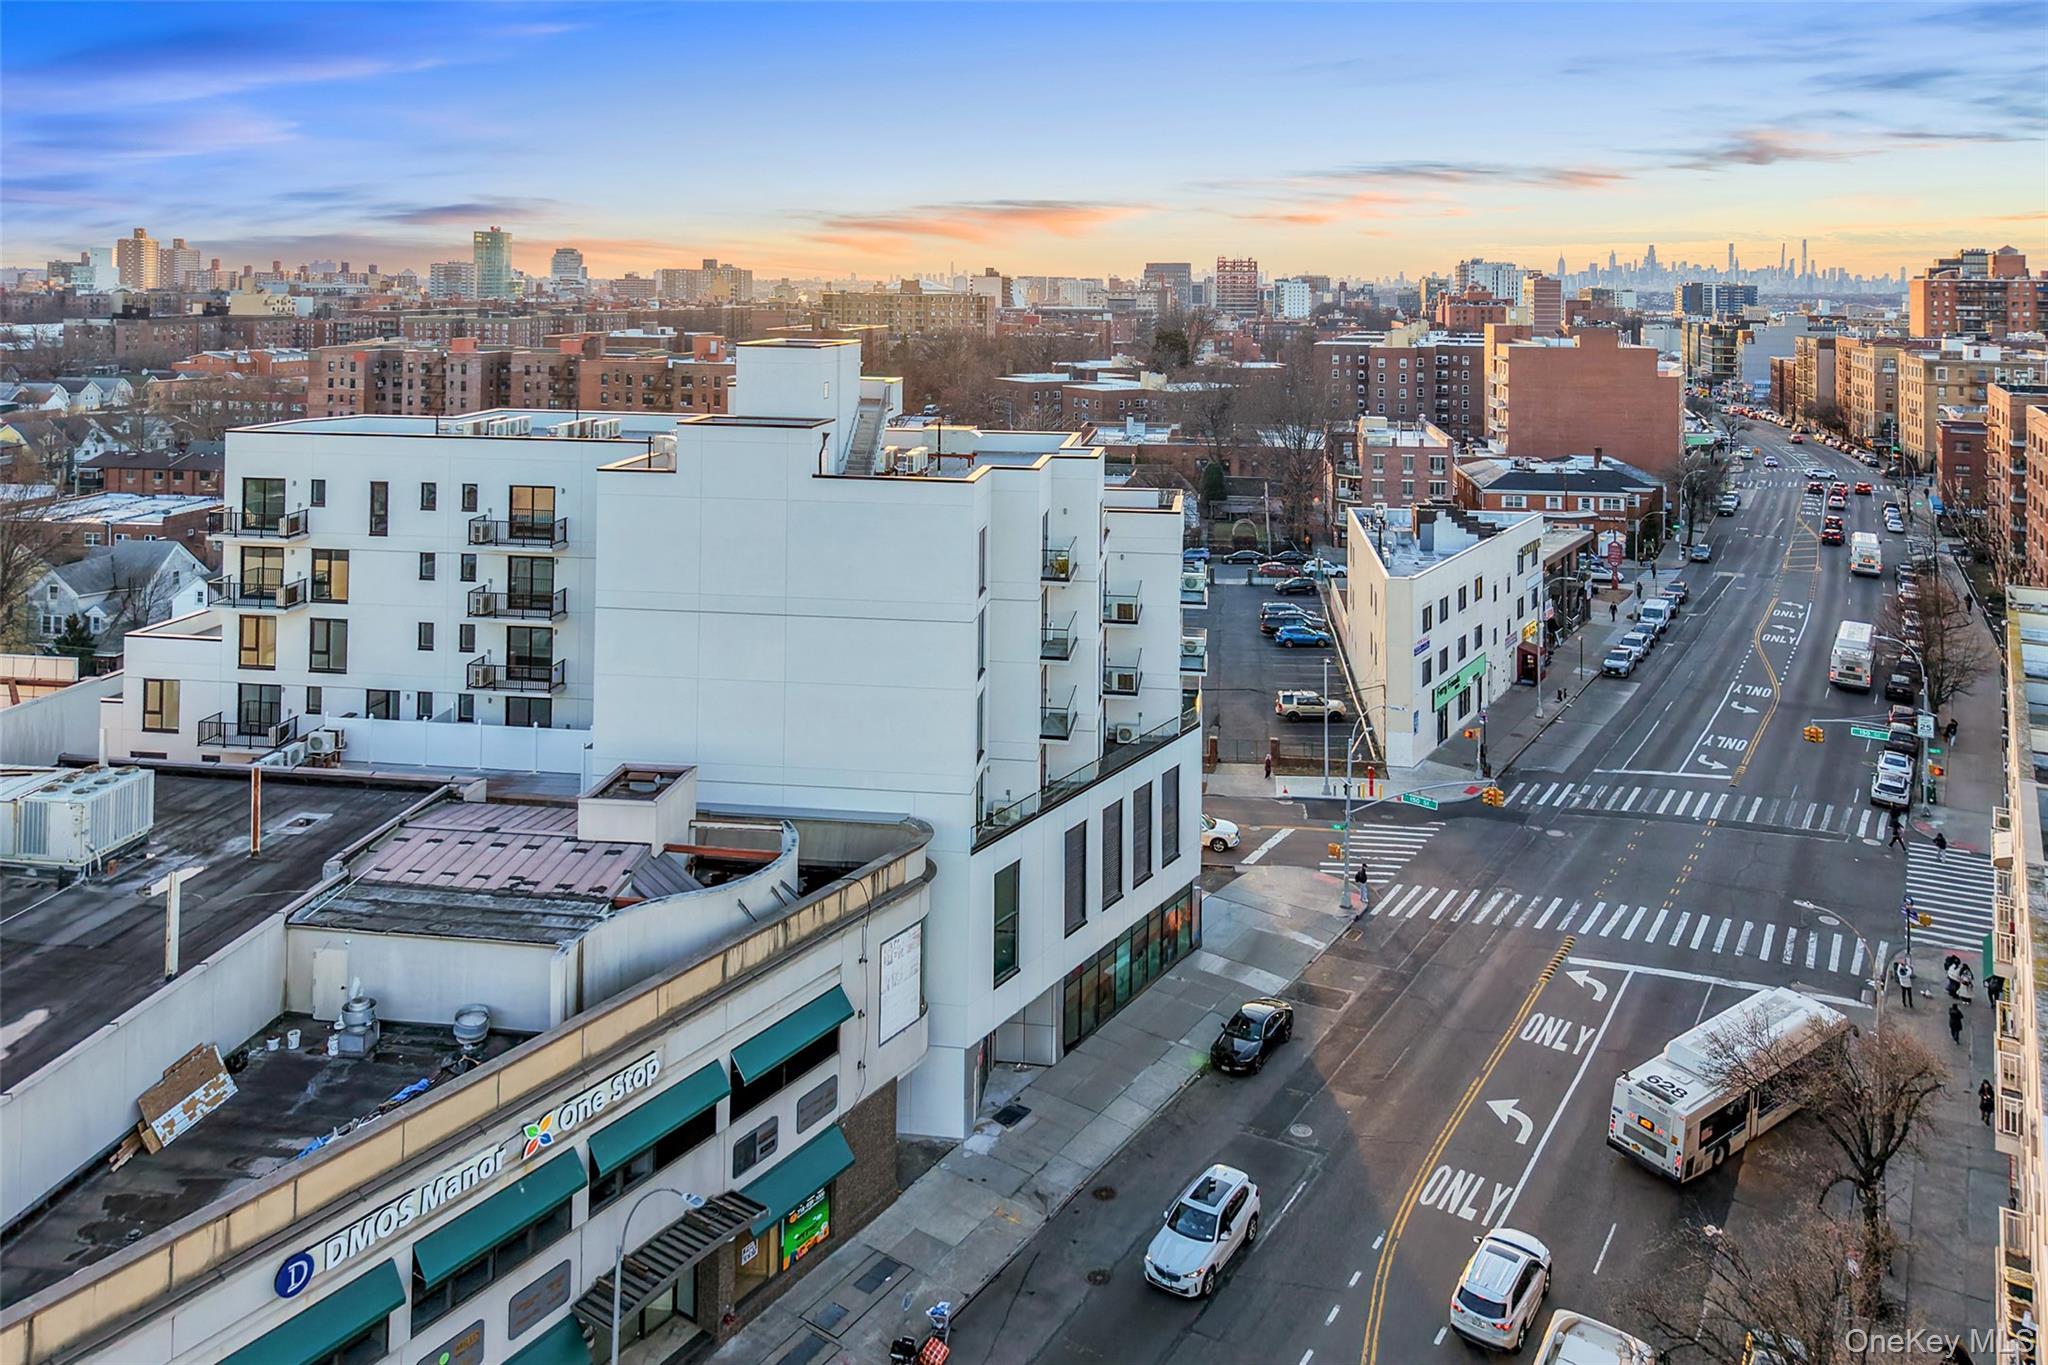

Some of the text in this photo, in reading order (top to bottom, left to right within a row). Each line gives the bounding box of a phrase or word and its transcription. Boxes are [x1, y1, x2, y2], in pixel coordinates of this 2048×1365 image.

[1772, 609, 1805, 619] ONLY
[1762, 633, 1797, 645] ONLY
[1732, 684, 1772, 698] ONLY
[1920, 723, 1932, 731] 25
[1702, 734, 1748, 752] ONLY
[1519, 1012, 1596, 1055] ONLY
[559, 1058, 661, 1131] One Stop
[1647, 1074, 1688, 1099] 628
[1419, 1164, 1513, 1227] ONLY
[286, 1146, 507, 1293] D DMOS Manor
